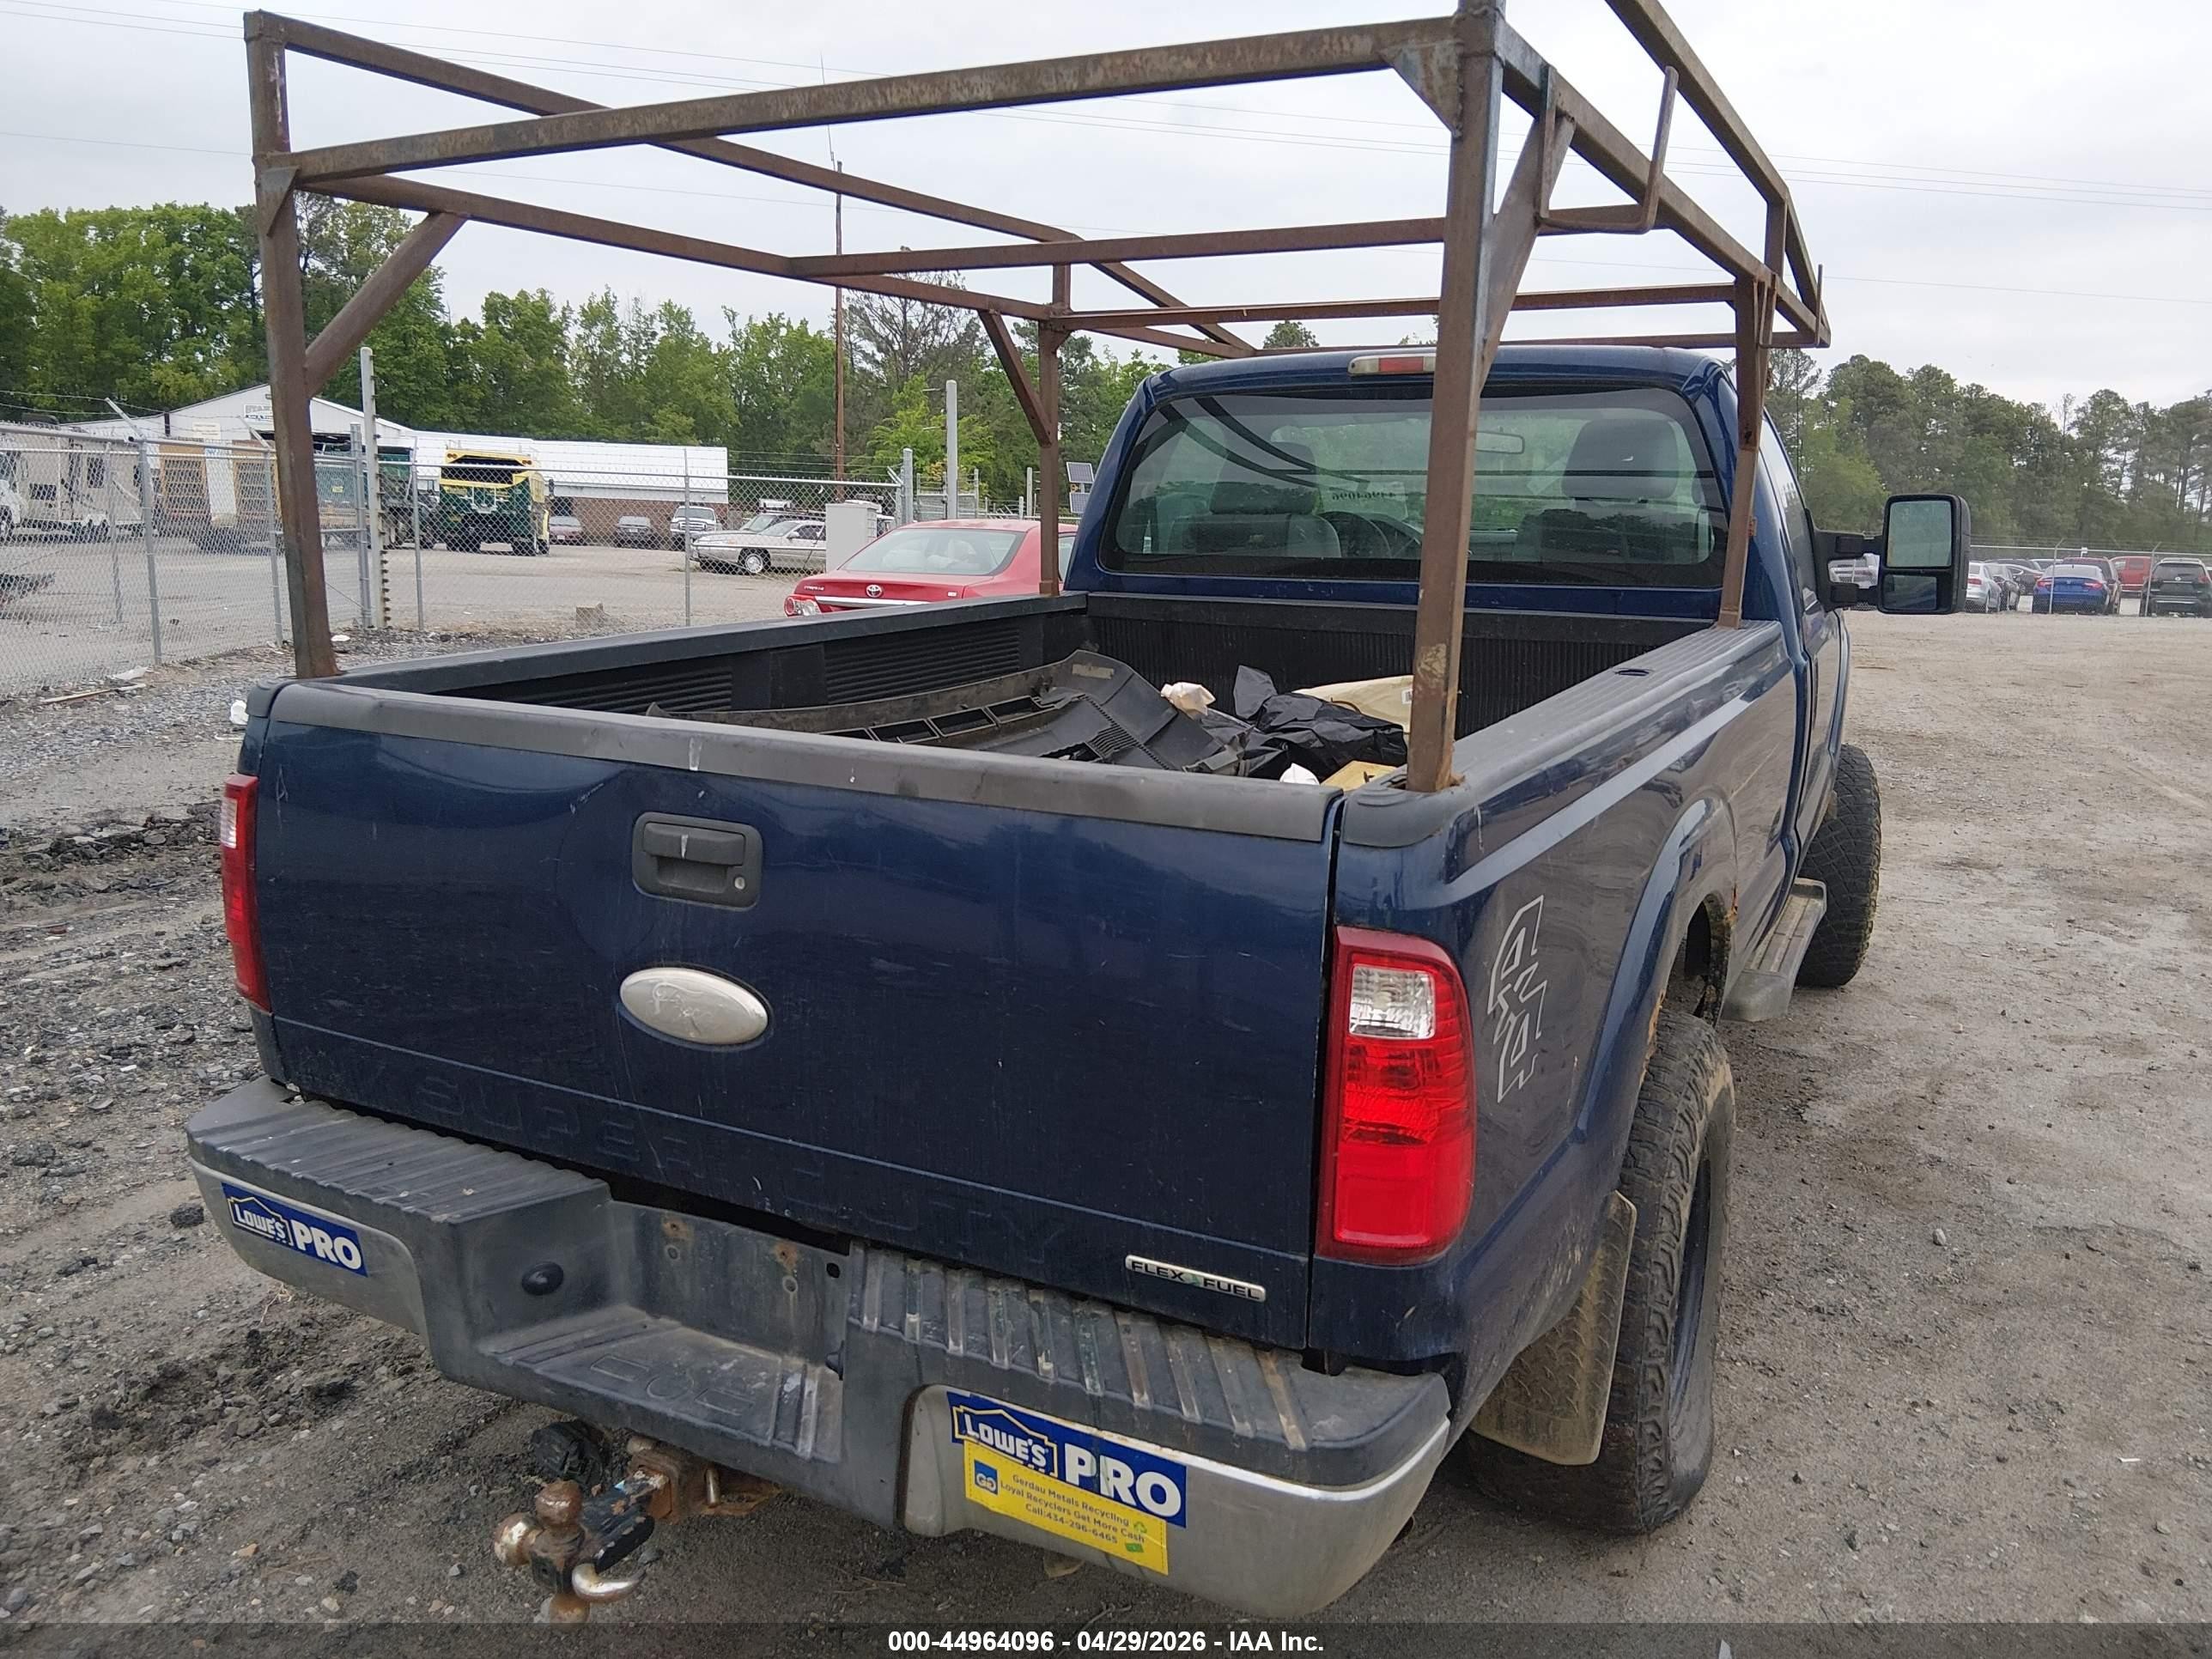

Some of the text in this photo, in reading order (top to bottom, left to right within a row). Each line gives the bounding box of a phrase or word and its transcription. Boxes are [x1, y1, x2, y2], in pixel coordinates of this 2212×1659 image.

[234, 1203, 362, 1270] LOWE'S PRO
[1131, 1261, 1260, 1300] FLEX FUEL
[963, 1413, 1182, 1517] LOWE'S PRO
[1000, 1480, 1024, 1497] Loyal
[1026, 1492, 1071, 1516] Recyclers
[1073, 1510, 1091, 1523] Get
[1093, 1517, 1118, 1533] More
[1121, 1528, 1145, 1543] Cash
[1012, 1474, 1045, 1494] Gerdau
[1048, 1488, 1079, 1506] Metals
[1082, 1501, 1129, 1526] Recycling
